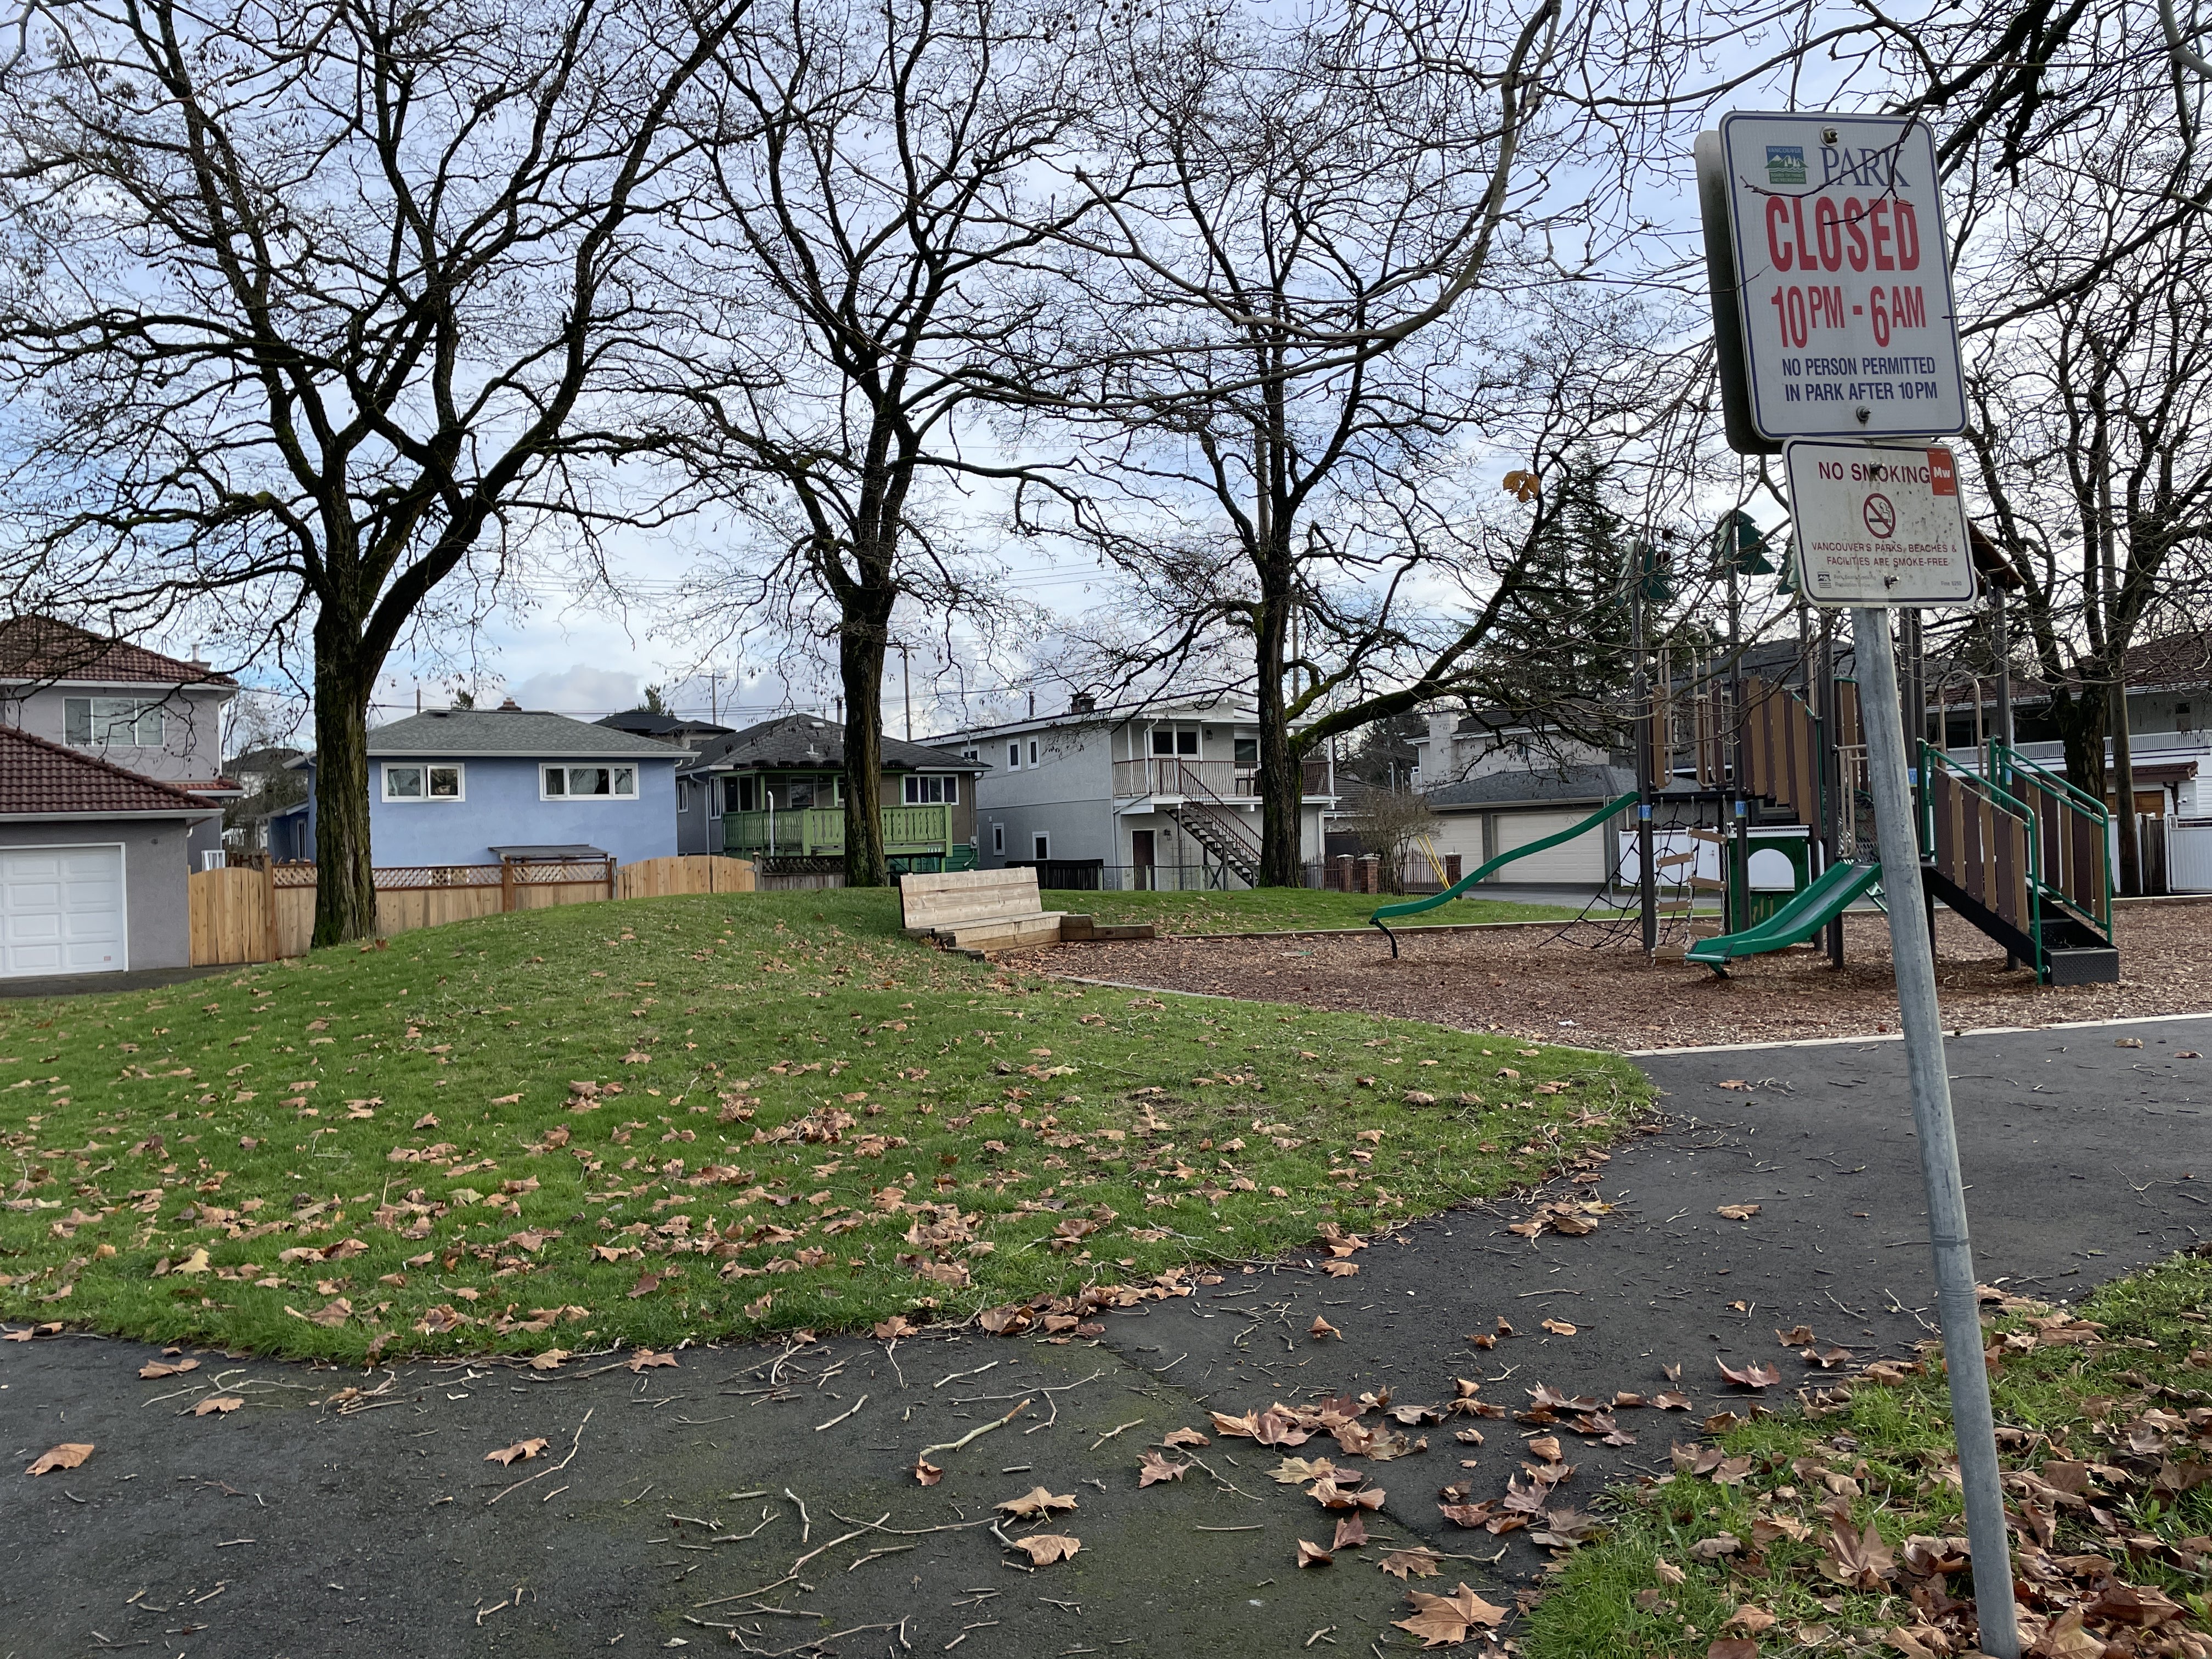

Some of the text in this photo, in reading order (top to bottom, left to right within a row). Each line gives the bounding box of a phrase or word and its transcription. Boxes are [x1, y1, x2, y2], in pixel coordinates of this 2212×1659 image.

[1818, 146, 1911, 187] PARK
[1766, 196, 1920, 272] CLOSED
[1782, 357, 1935, 376] NO PERSON PERMITTED
[1785, 384, 1801, 401] IN
[1805, 383, 1844, 401] PARK
[1849, 382, 1894, 400] AFTER
[1819, 461, 1931, 484] NO SMOKING
[1908, 544, 1948, 552] BEACHES
[1827, 556, 1949, 566] FACILITIES ARE SMOKE-FREE
